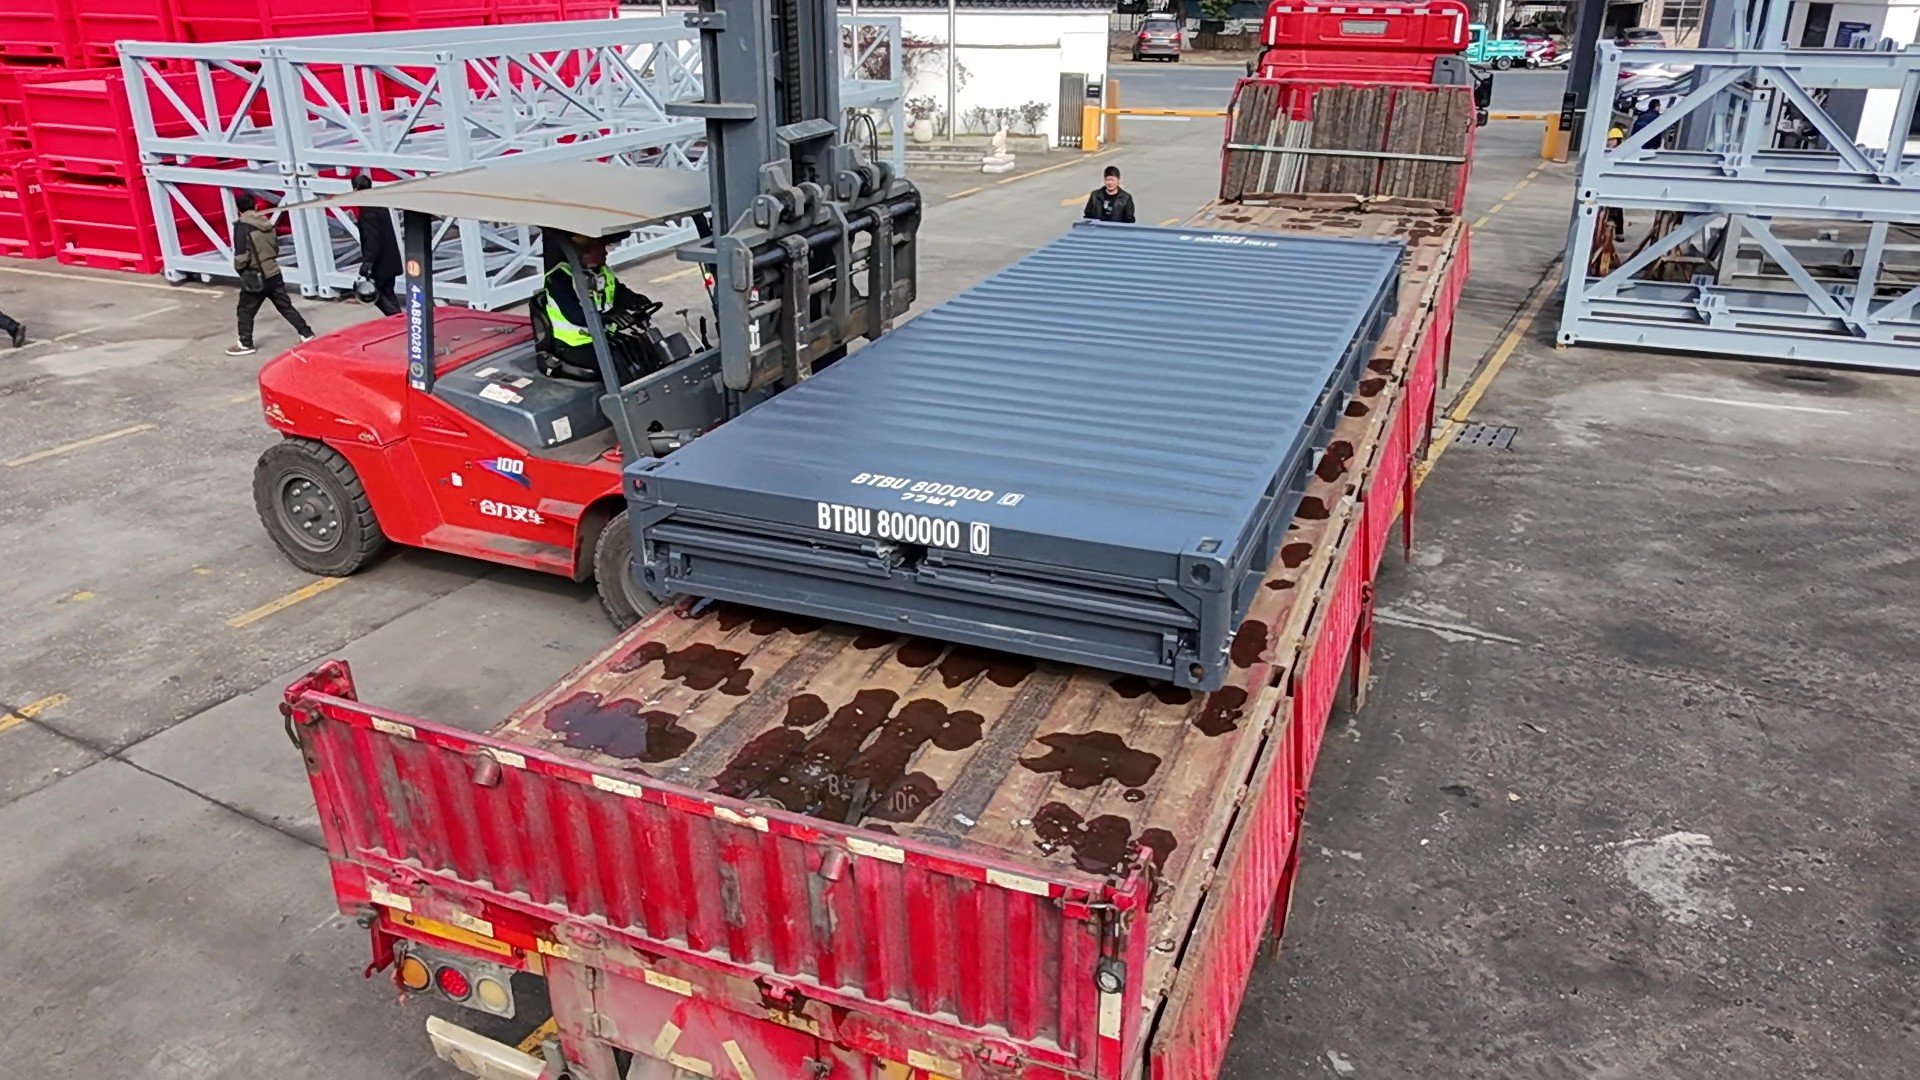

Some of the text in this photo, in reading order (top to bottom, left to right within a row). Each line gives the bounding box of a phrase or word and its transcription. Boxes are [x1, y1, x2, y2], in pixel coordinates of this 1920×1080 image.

[496, 457, 524, 474] 100
[851, 472, 1021, 505] BTBU 800000 0
[480, 499, 545, 525] 合力叉车
[817, 502, 988, 554] BTBU 800000 0
